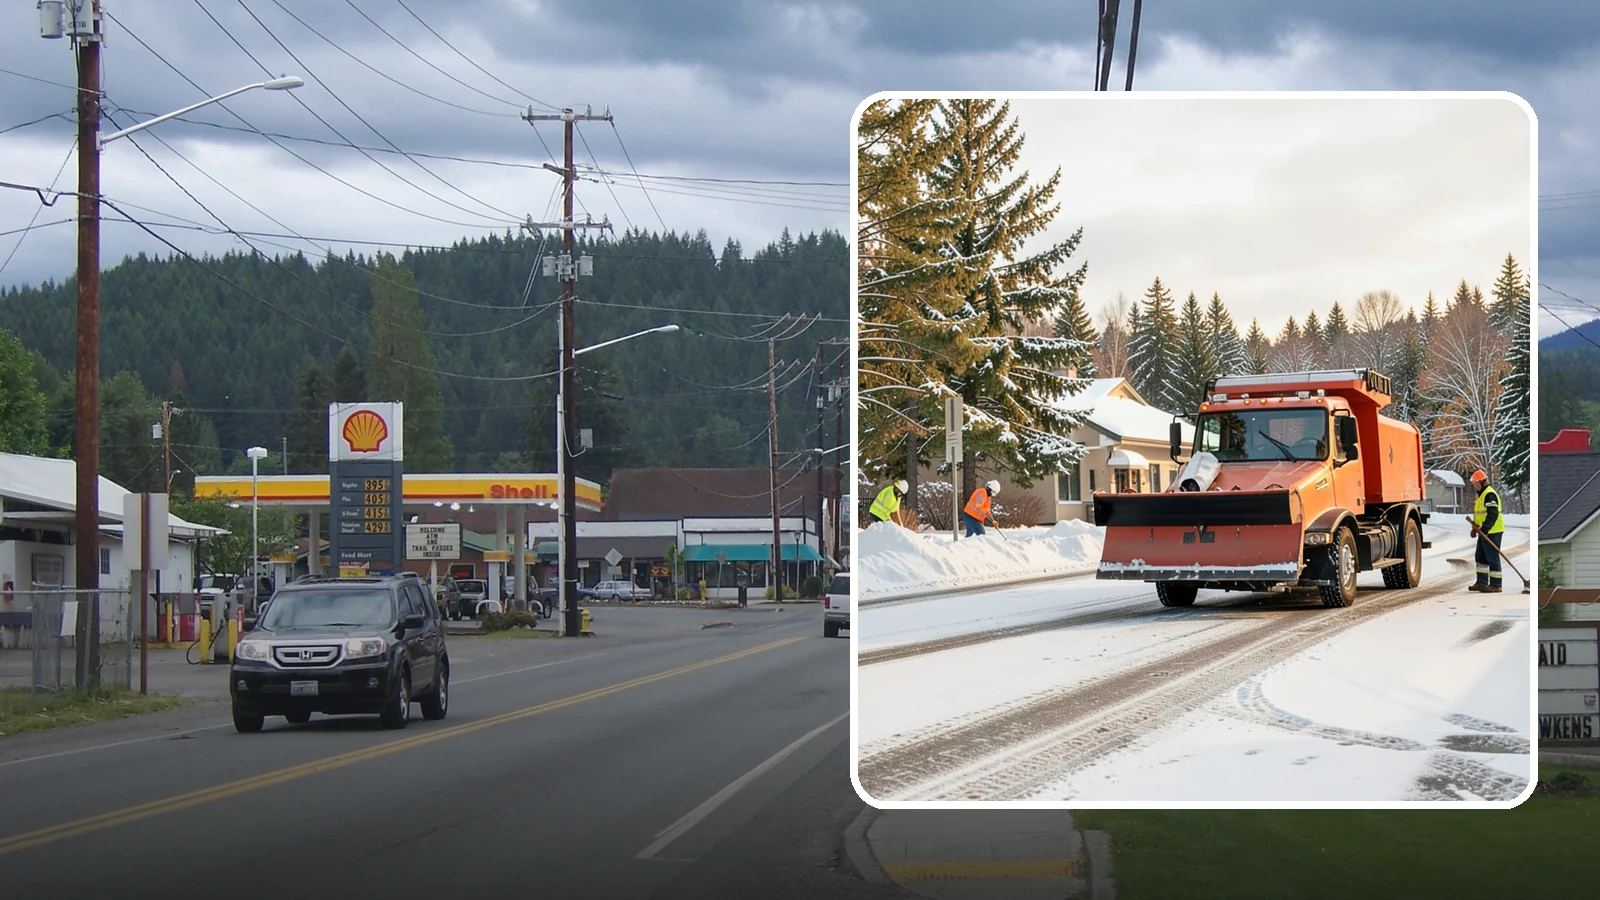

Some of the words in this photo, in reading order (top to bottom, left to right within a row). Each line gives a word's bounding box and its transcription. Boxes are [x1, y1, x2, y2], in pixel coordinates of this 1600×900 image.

[366, 480, 383, 490] 395
[490, 484, 547, 499] Shell
[366, 494, 383, 504] 405
[366, 508, 383, 518] 415
[366, 522, 383, 532] 429
[1539, 643, 1566, 665] AID
